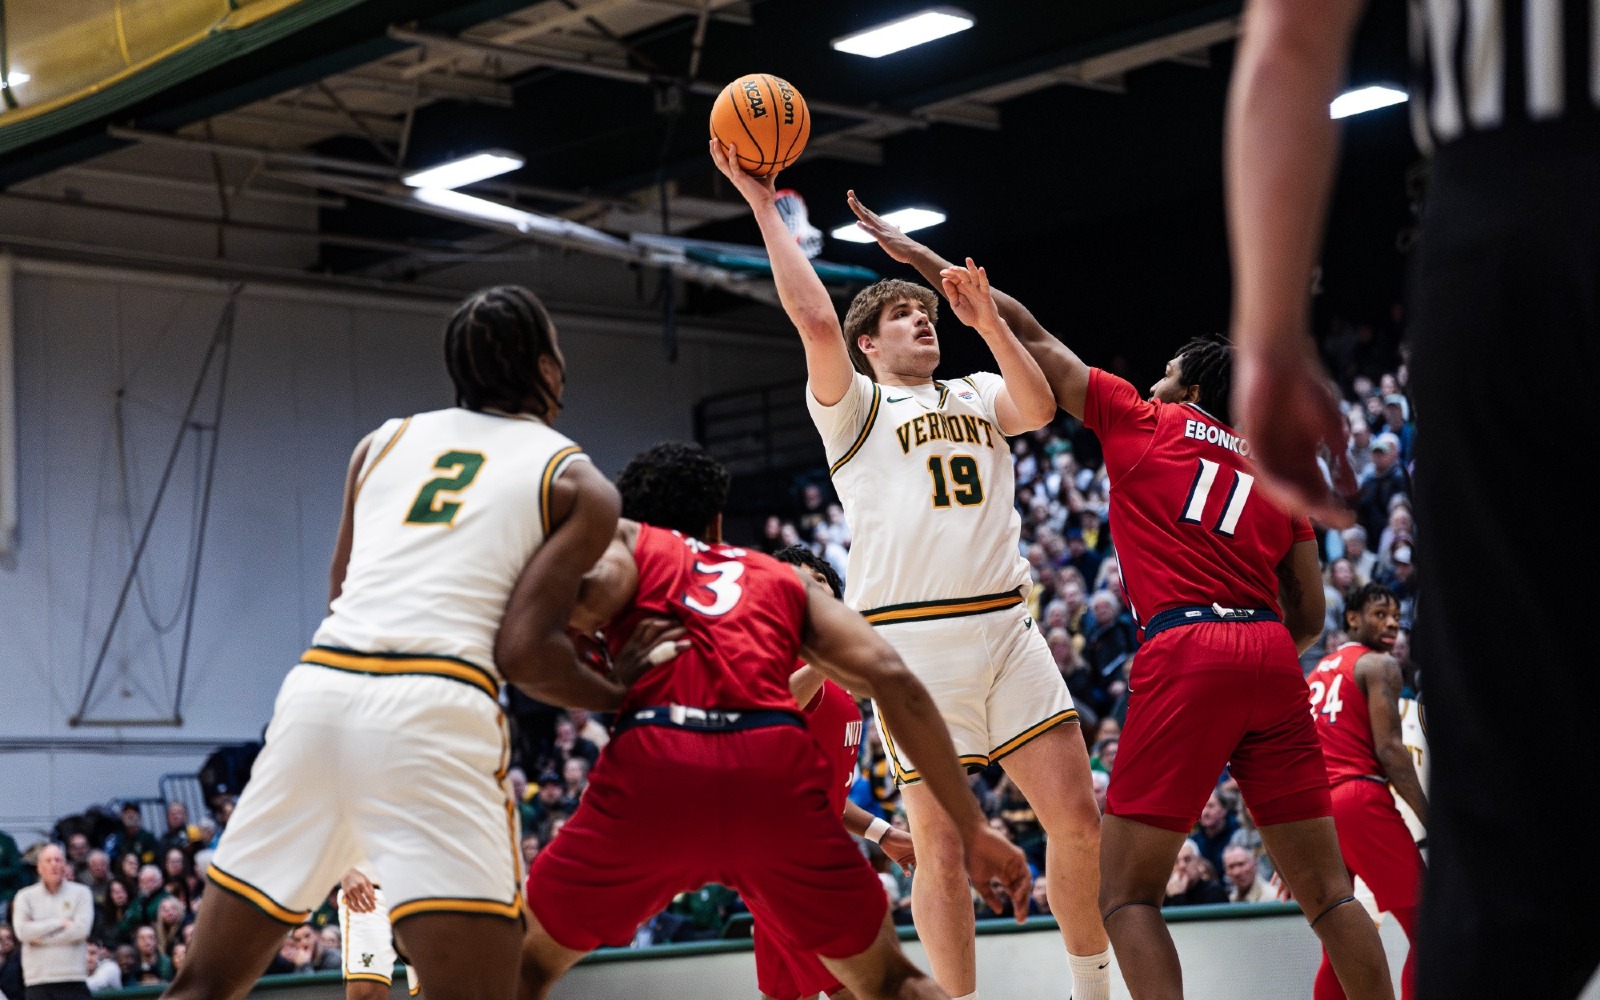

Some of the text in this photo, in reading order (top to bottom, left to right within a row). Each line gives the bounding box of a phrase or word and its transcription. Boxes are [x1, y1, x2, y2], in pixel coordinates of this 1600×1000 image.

[742, 80, 767, 119] NCAA
[895, 411, 994, 455] VERMONT
[1184, 419, 1253, 458] EBONKO
[402, 449, 487, 528] 2
[926, 454, 985, 509] 19
[1178, 457, 1255, 538] 11
[682, 560, 745, 617] 3
[1308, 673, 1343, 724] 24
